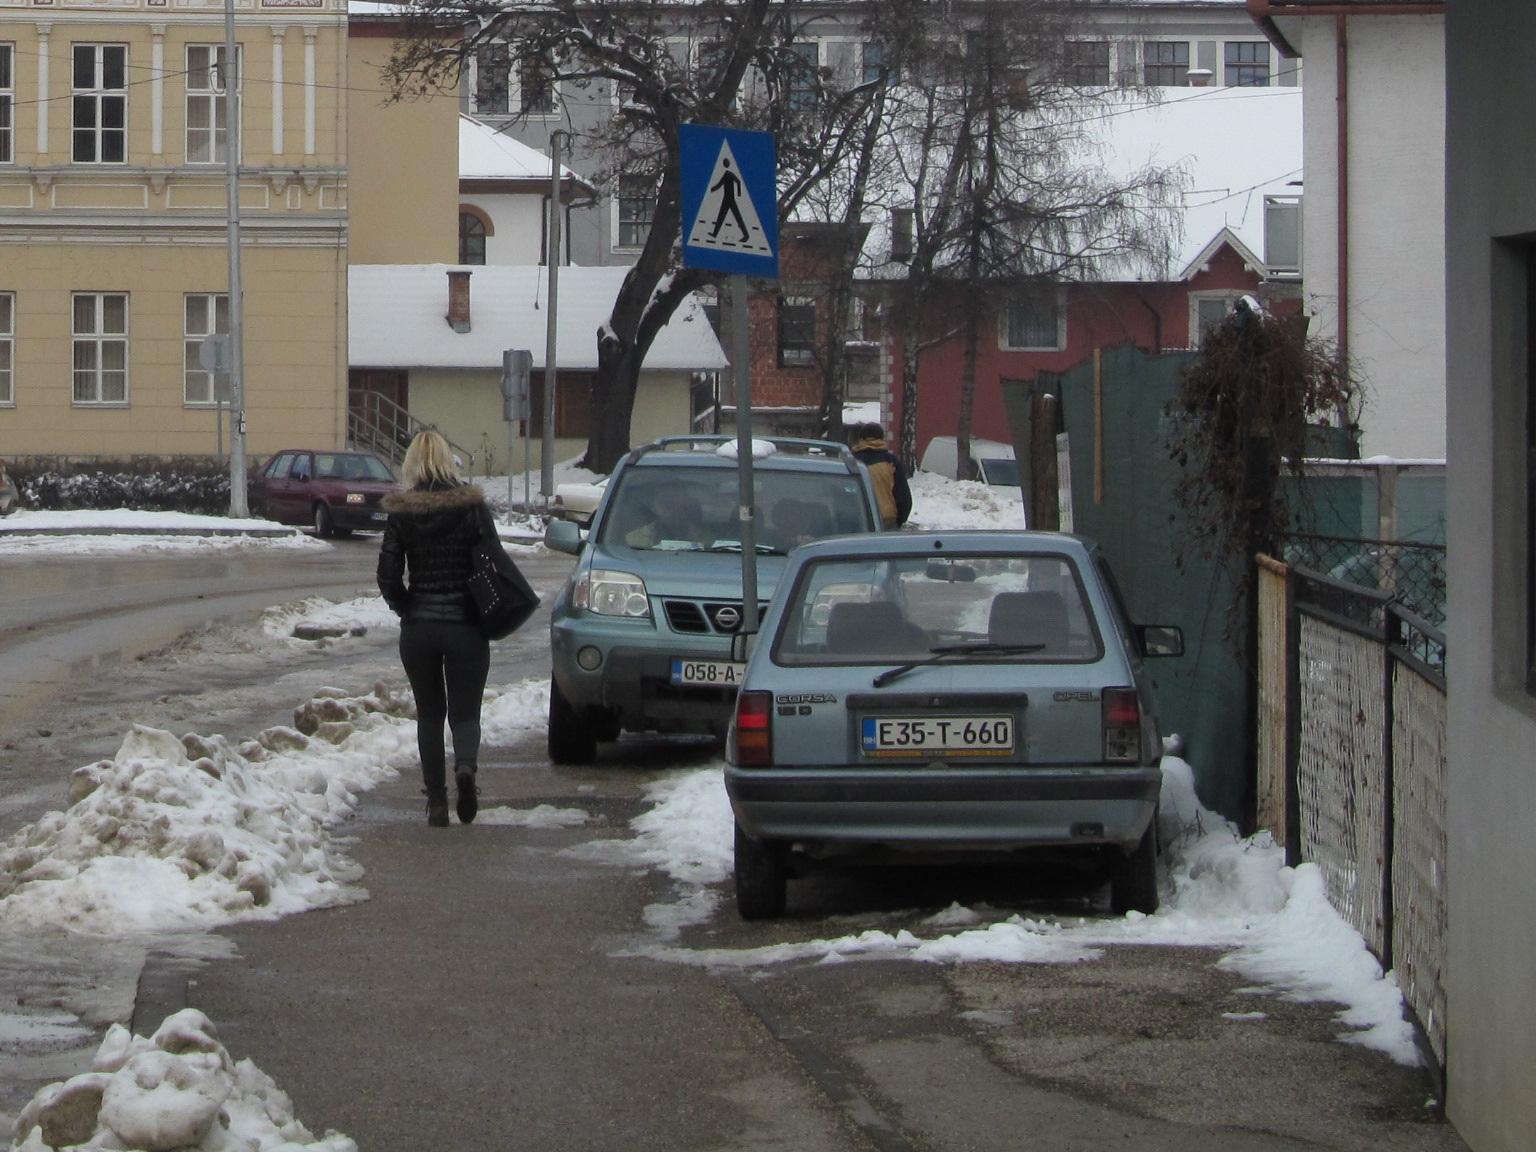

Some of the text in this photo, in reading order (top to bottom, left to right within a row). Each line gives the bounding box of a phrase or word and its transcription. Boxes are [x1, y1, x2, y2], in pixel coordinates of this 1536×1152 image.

[776, 693, 837, 704] CORSA
[1053, 691, 1100, 702] OPEL
[879, 721, 1009, 746] E35-T-660
